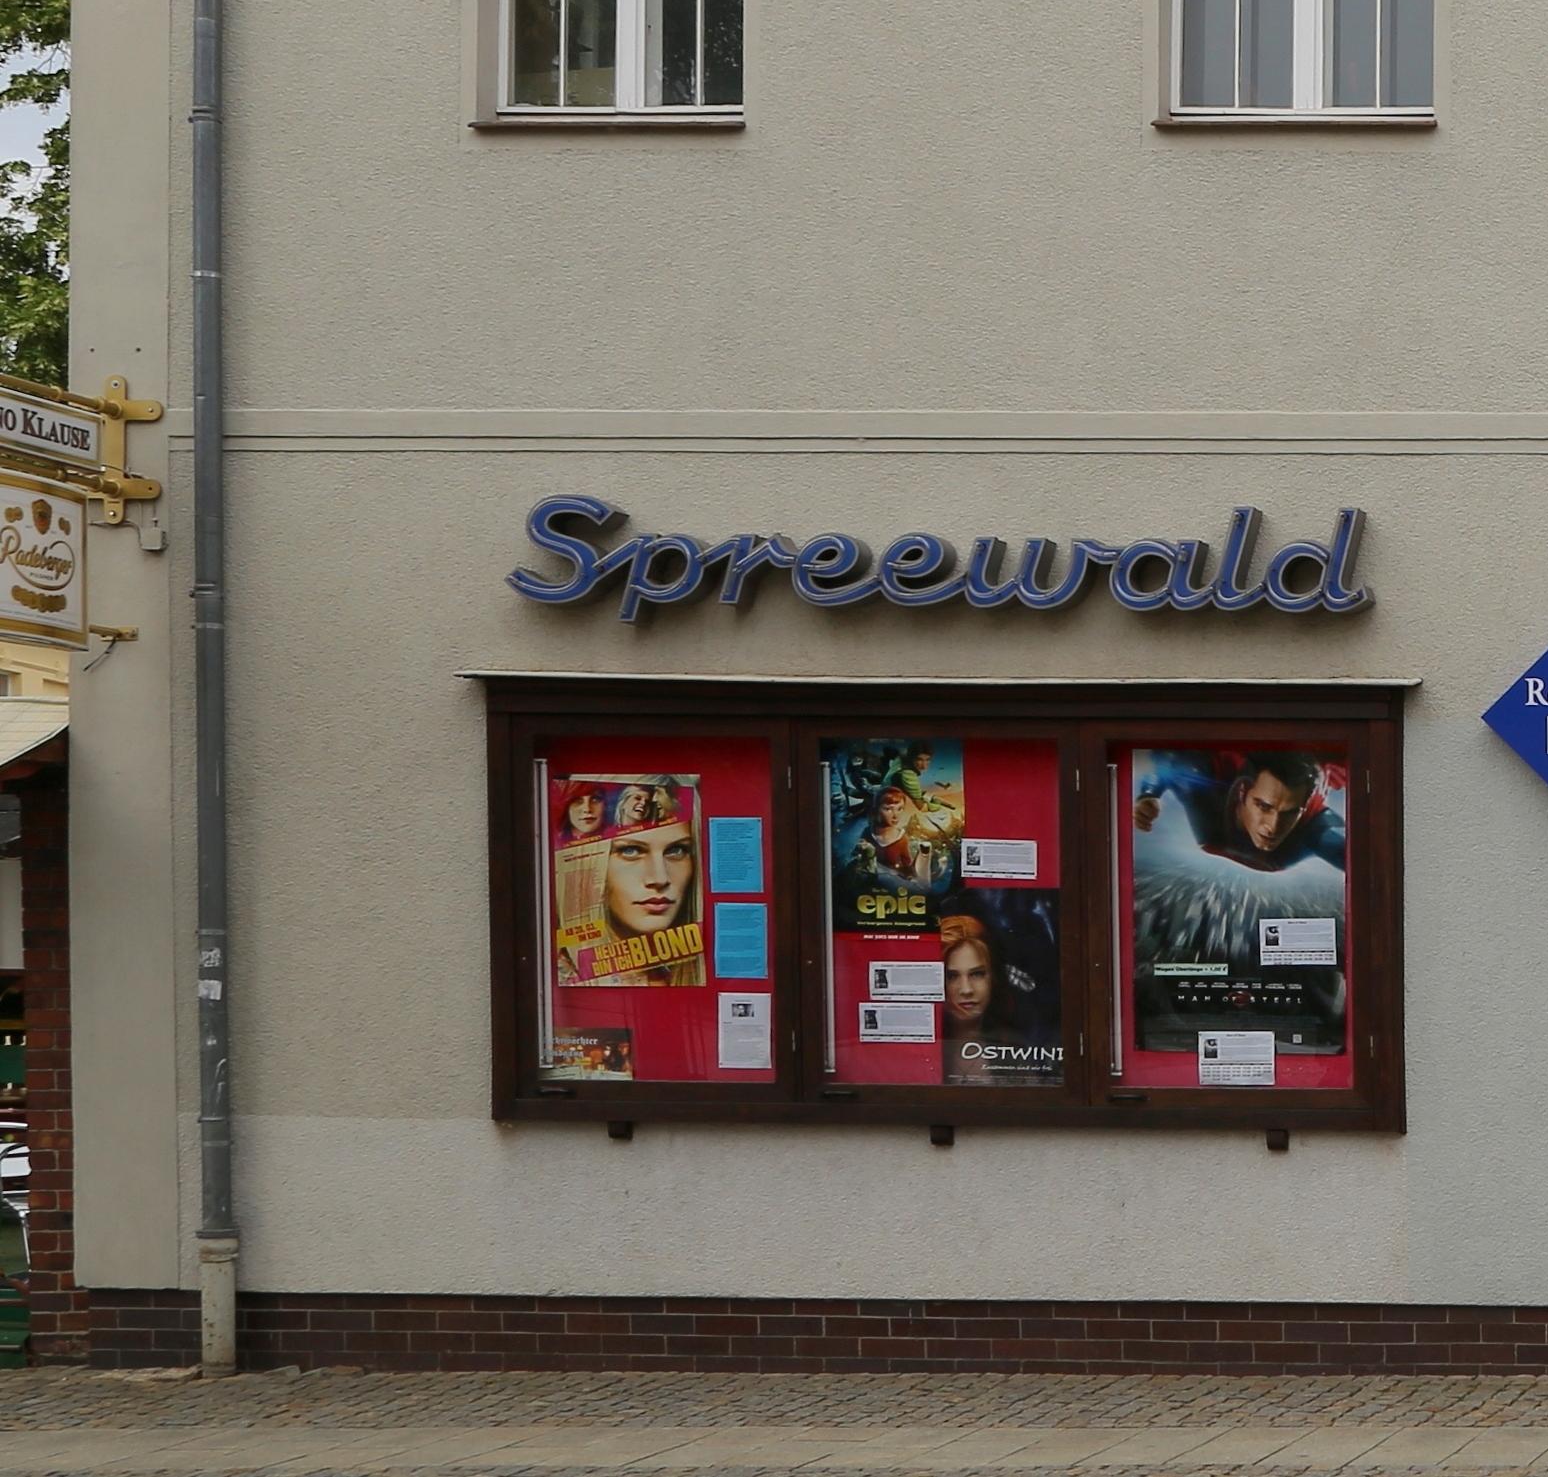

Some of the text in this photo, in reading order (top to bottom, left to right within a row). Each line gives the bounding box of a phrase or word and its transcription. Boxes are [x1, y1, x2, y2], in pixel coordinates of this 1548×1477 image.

[21, 408, 91, 451] KLAUSE
[504, 494, 1374, 624] Spreewald
[857, 886, 926, 919] epic
[594, 939, 630, 960] HEUTE
[615, 954, 632, 972] ICH
[628, 923, 704, 967] BLOND
